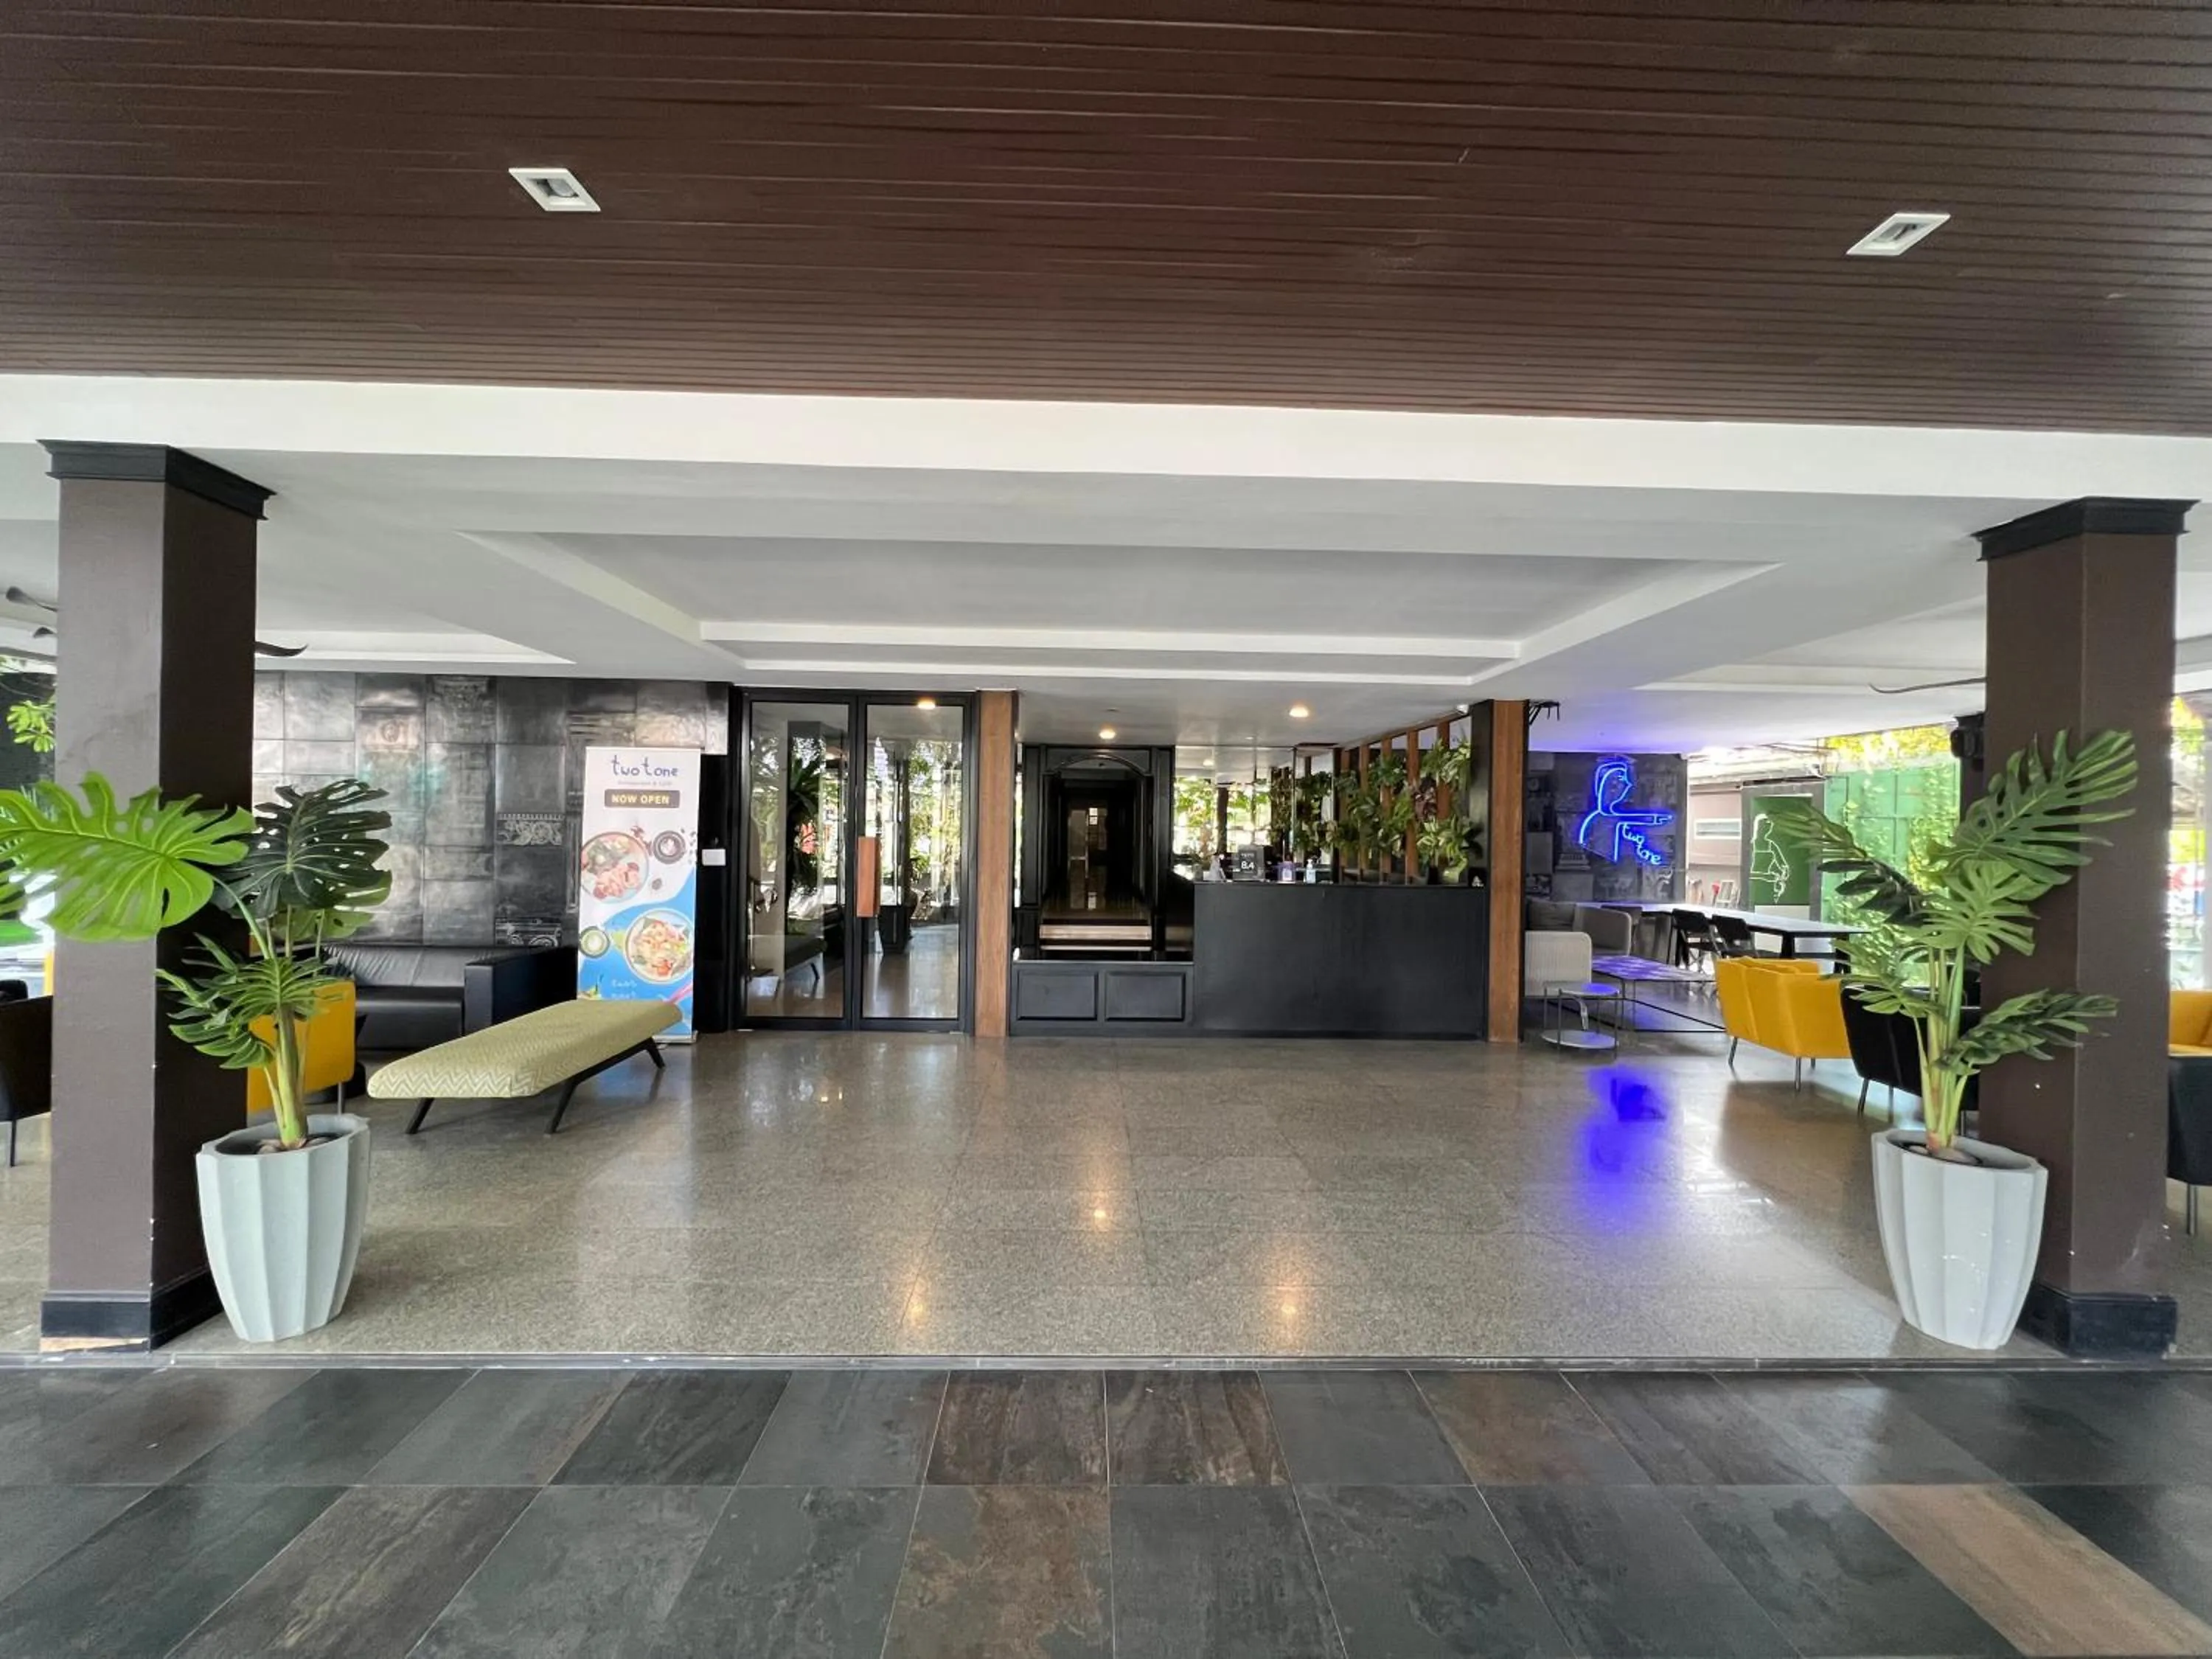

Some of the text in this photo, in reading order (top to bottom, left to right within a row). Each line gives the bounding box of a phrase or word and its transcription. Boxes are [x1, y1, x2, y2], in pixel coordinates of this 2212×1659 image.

[611, 754, 678, 776] two tone
[612, 793, 670, 804] NOW OPEN
[1241, 861, 1255, 870] 8.4
